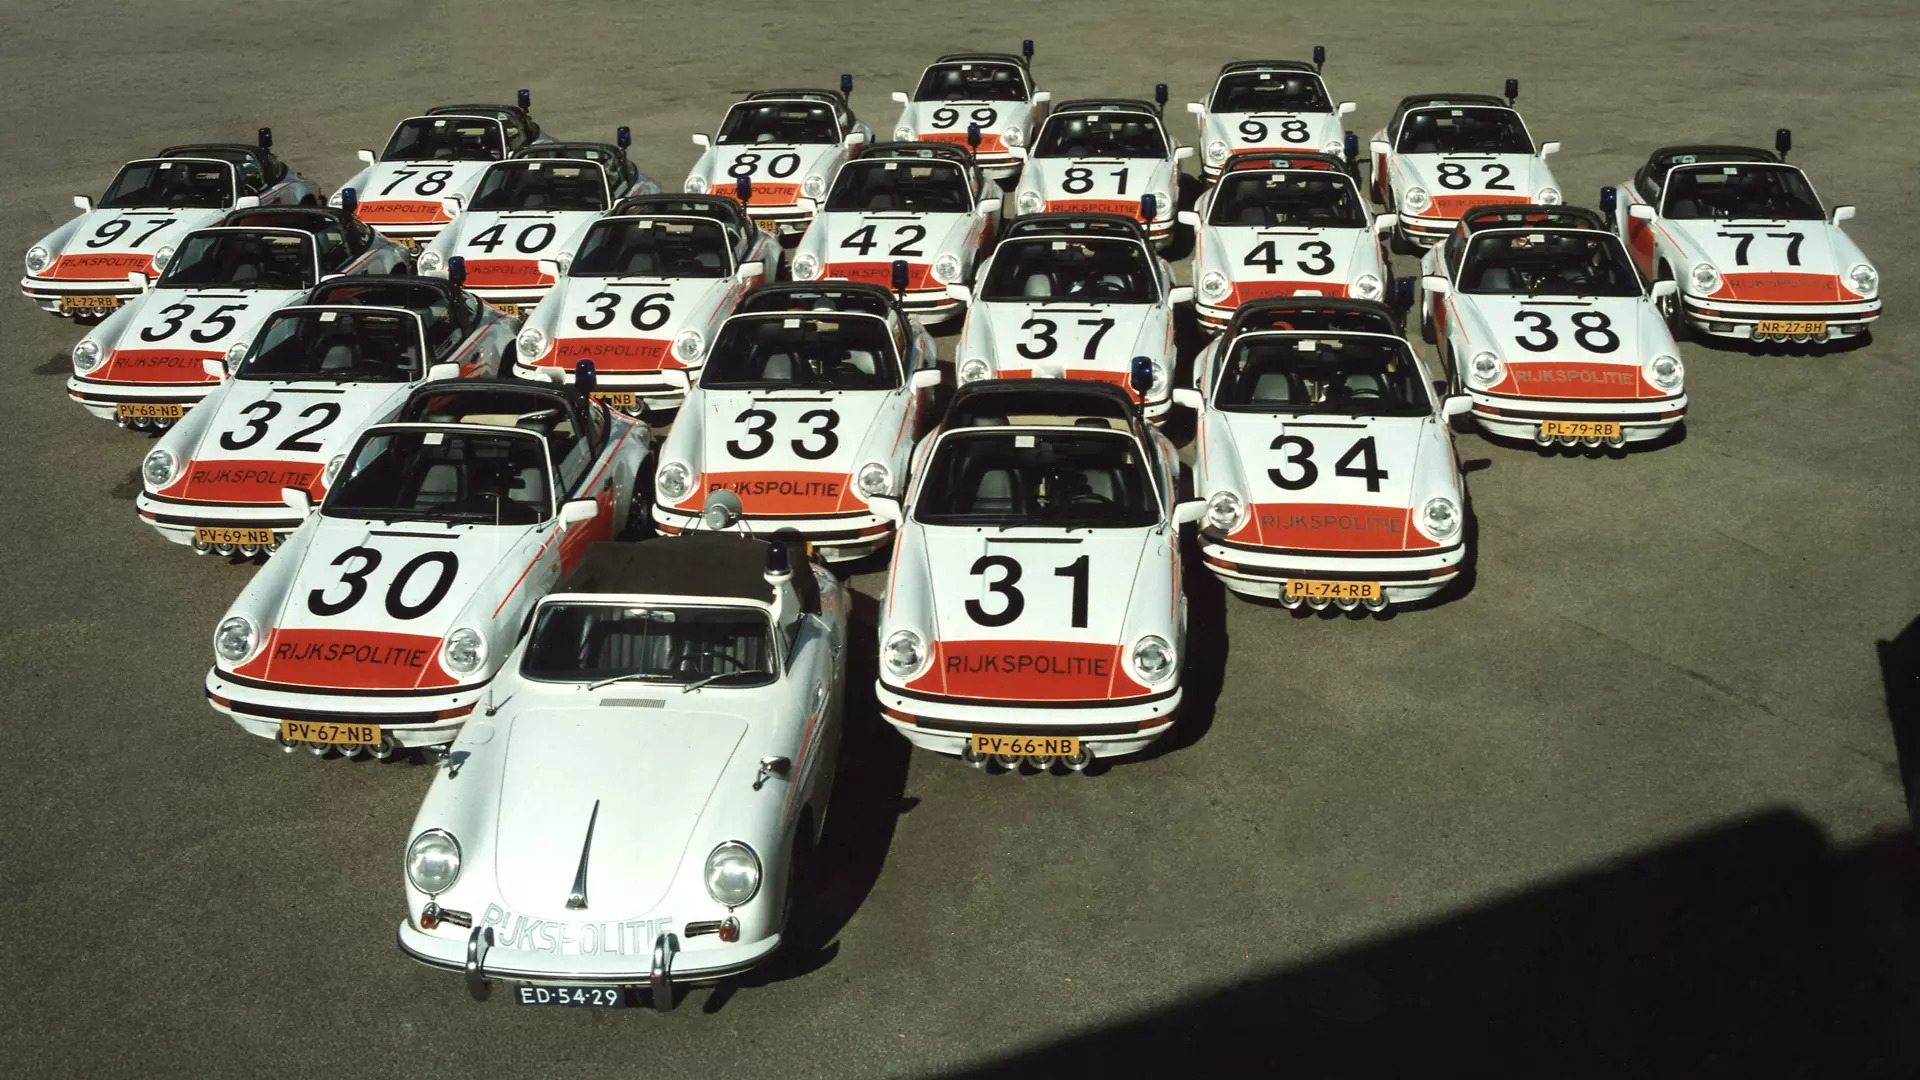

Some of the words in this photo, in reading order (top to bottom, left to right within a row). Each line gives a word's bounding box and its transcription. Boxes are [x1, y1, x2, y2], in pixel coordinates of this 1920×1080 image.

[932, 108, 997, 131] 99
[1239, 120, 1310, 143] 98
[728, 154, 800, 182] 80
[1437, 163, 1514, 190] 82
[381, 171, 452, 195] 78
[1063, 168, 1128, 194] 81
[360, 204, 439, 214] RIJKSPOLITIE
[1052, 203, 1137, 213] RIJKSPOLITIE
[87, 219, 177, 248] 97
[468, 223, 556, 253] 40
[841, 225, 926, 256] 42
[1245, 241, 1334, 275] 43
[1717, 232, 1804, 265] 77
[61, 256, 147, 269] RIJKSPOLITIE
[1730, 278, 1835, 291] RIJKSPOLITIE
[65, 297, 112, 307] PL-72-RB
[577, 292, 674, 331] 36
[141, 304, 248, 343] 35
[1514, 311, 1619, 353] 38
[1761, 321, 1823, 334] NR-27-BH
[1017, 318, 1114, 359] 37
[559, 344, 663, 359] RIJKSPOLITIE
[1515, 369, 1634, 386] RIJKSPOLITIE
[120, 404, 180, 417] PV-68-NB
[220, 400, 341, 452] 32
[727, 409, 839, 459] 33
[1547, 423, 1613, 436] PL-79-RB
[1268, 435, 1388, 492] 34
[191, 470, 313, 486] RIJKSPOLITIE
[199, 528, 269, 543] PV-69-NB
[1261, 515, 1403, 534] RIJKSPOLITIE
[308, 546, 458, 619] 30
[965, 555, 1089, 628] 31
[1294, 583, 1371, 597] PL-74-RB
[274, 642, 427, 668] RIJKSPOLITIE
[946, 655, 1110, 677] RIJKSPOLITIE
[287, 722, 374, 743] PV-67-NB
[978, 737, 1073, 755] PV-66-NB
